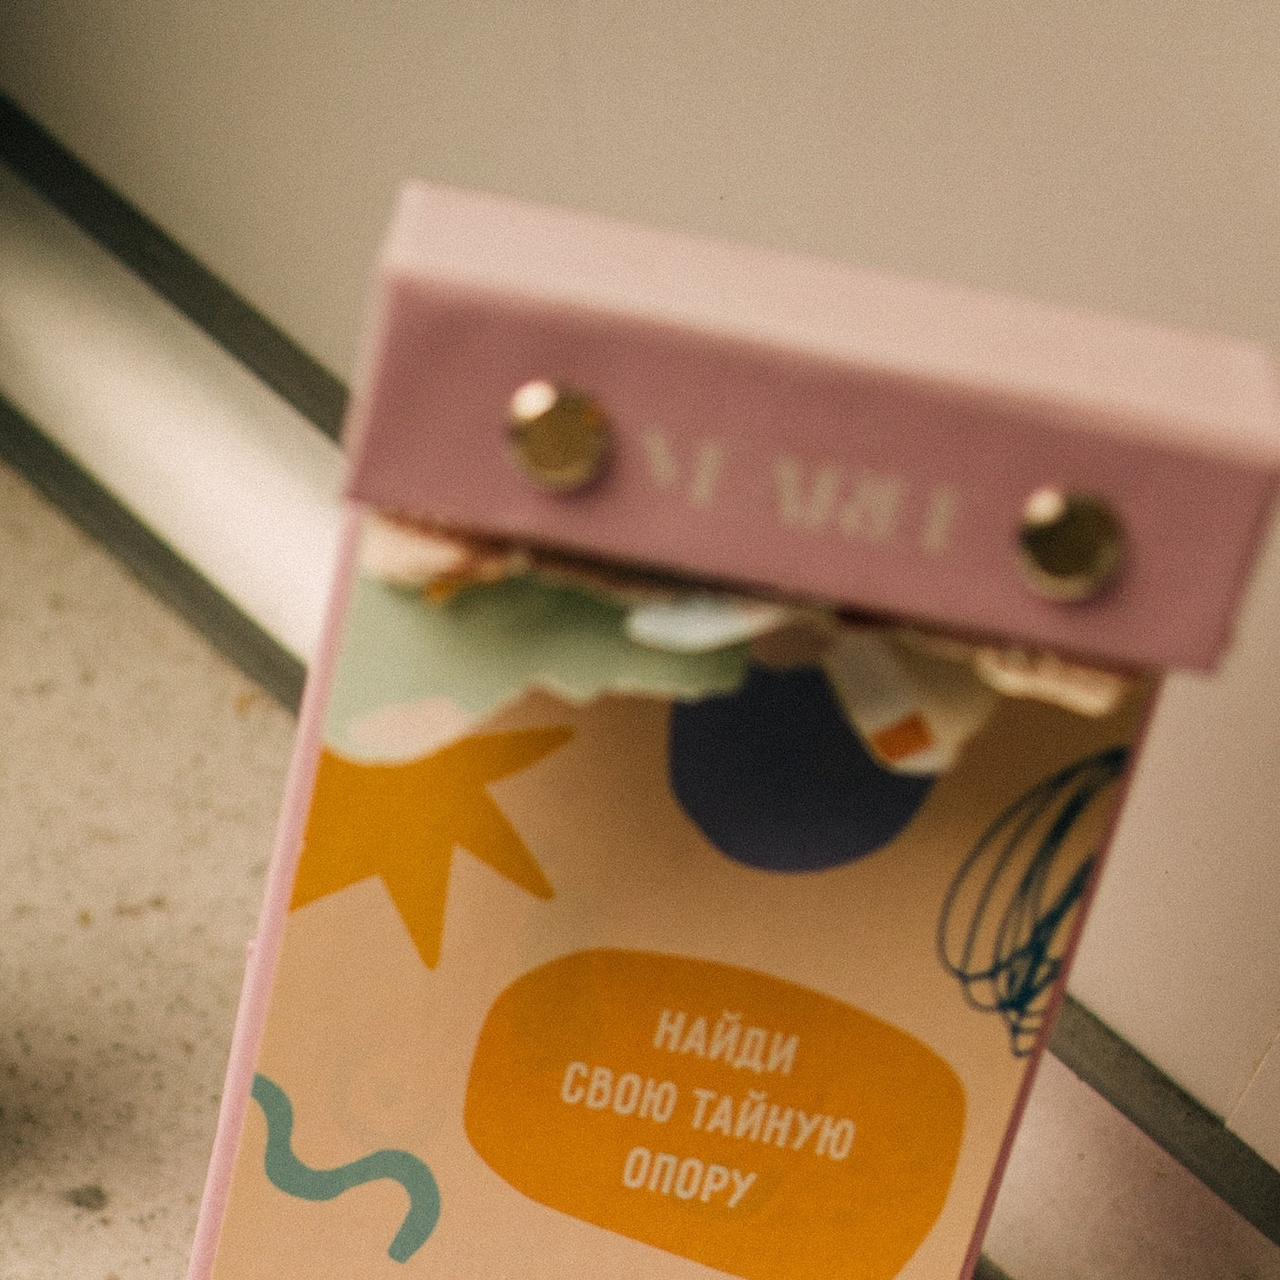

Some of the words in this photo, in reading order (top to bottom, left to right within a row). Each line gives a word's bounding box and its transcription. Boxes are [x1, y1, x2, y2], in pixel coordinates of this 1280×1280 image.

[652, 1008, 801, 1077] НАЙДИ
[560, 1060, 679, 1124] СВОЮ
[691, 1087, 857, 1162] ТАЙНУЮ
[622, 1146, 758, 1209] ОПОРУ
